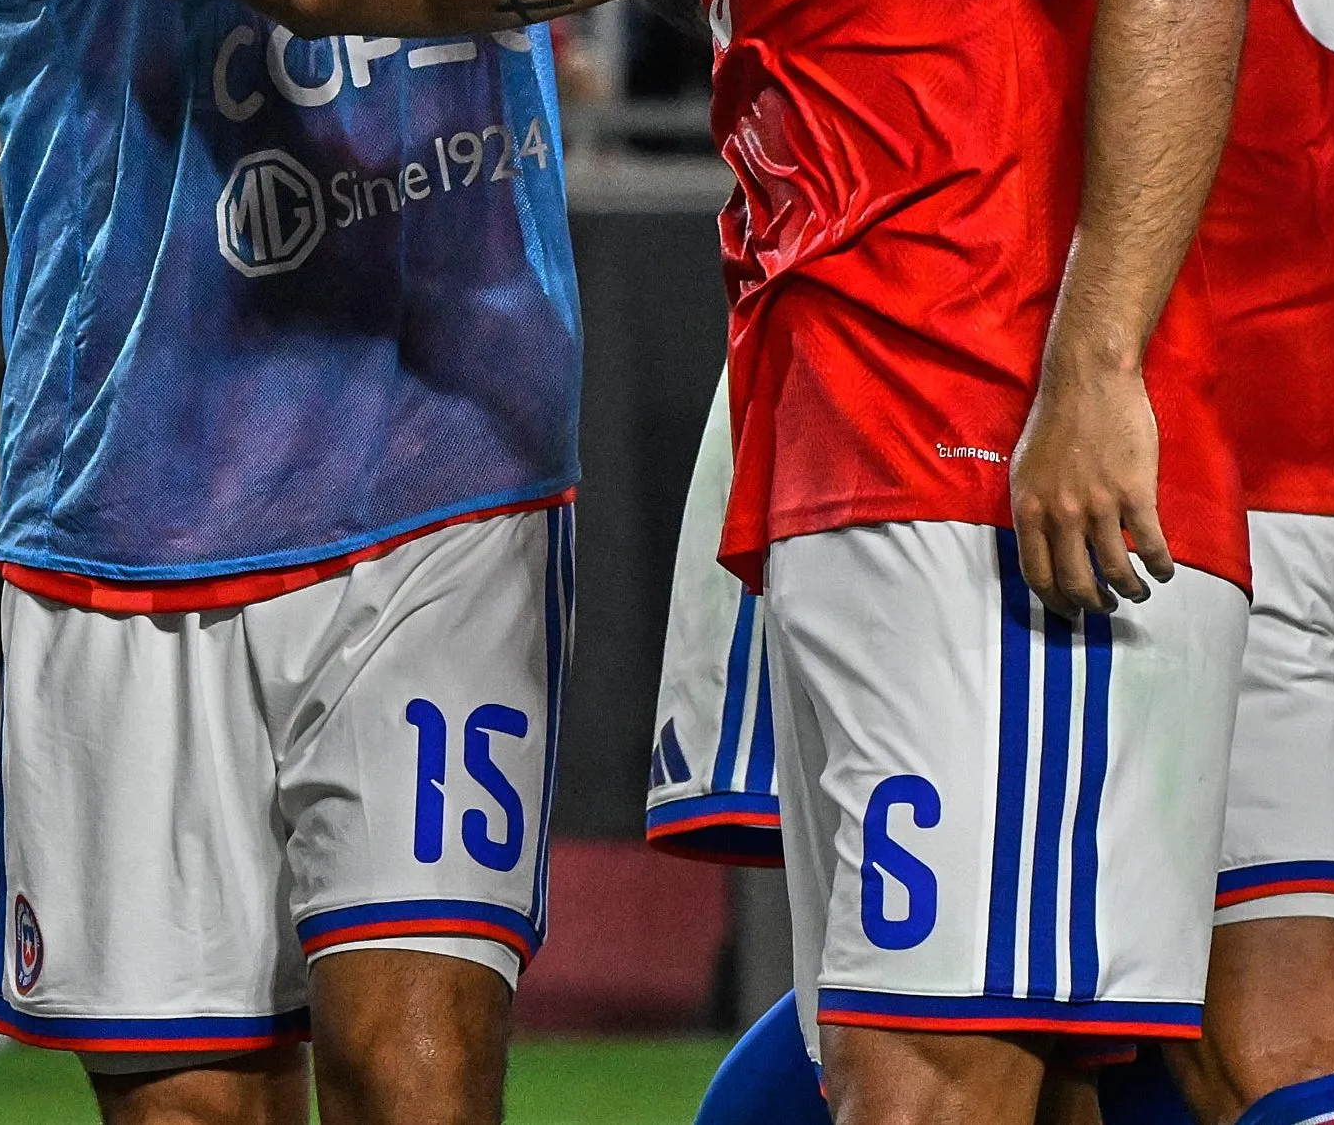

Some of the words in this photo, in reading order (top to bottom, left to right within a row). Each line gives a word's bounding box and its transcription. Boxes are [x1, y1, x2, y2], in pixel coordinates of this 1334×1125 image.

[228, 164, 315, 264] MG
[331, 162, 431, 228] Since
[434, 117, 549, 193] 1924
[405, 697, 529, 873] 15
[860, 774, 943, 952] 6
